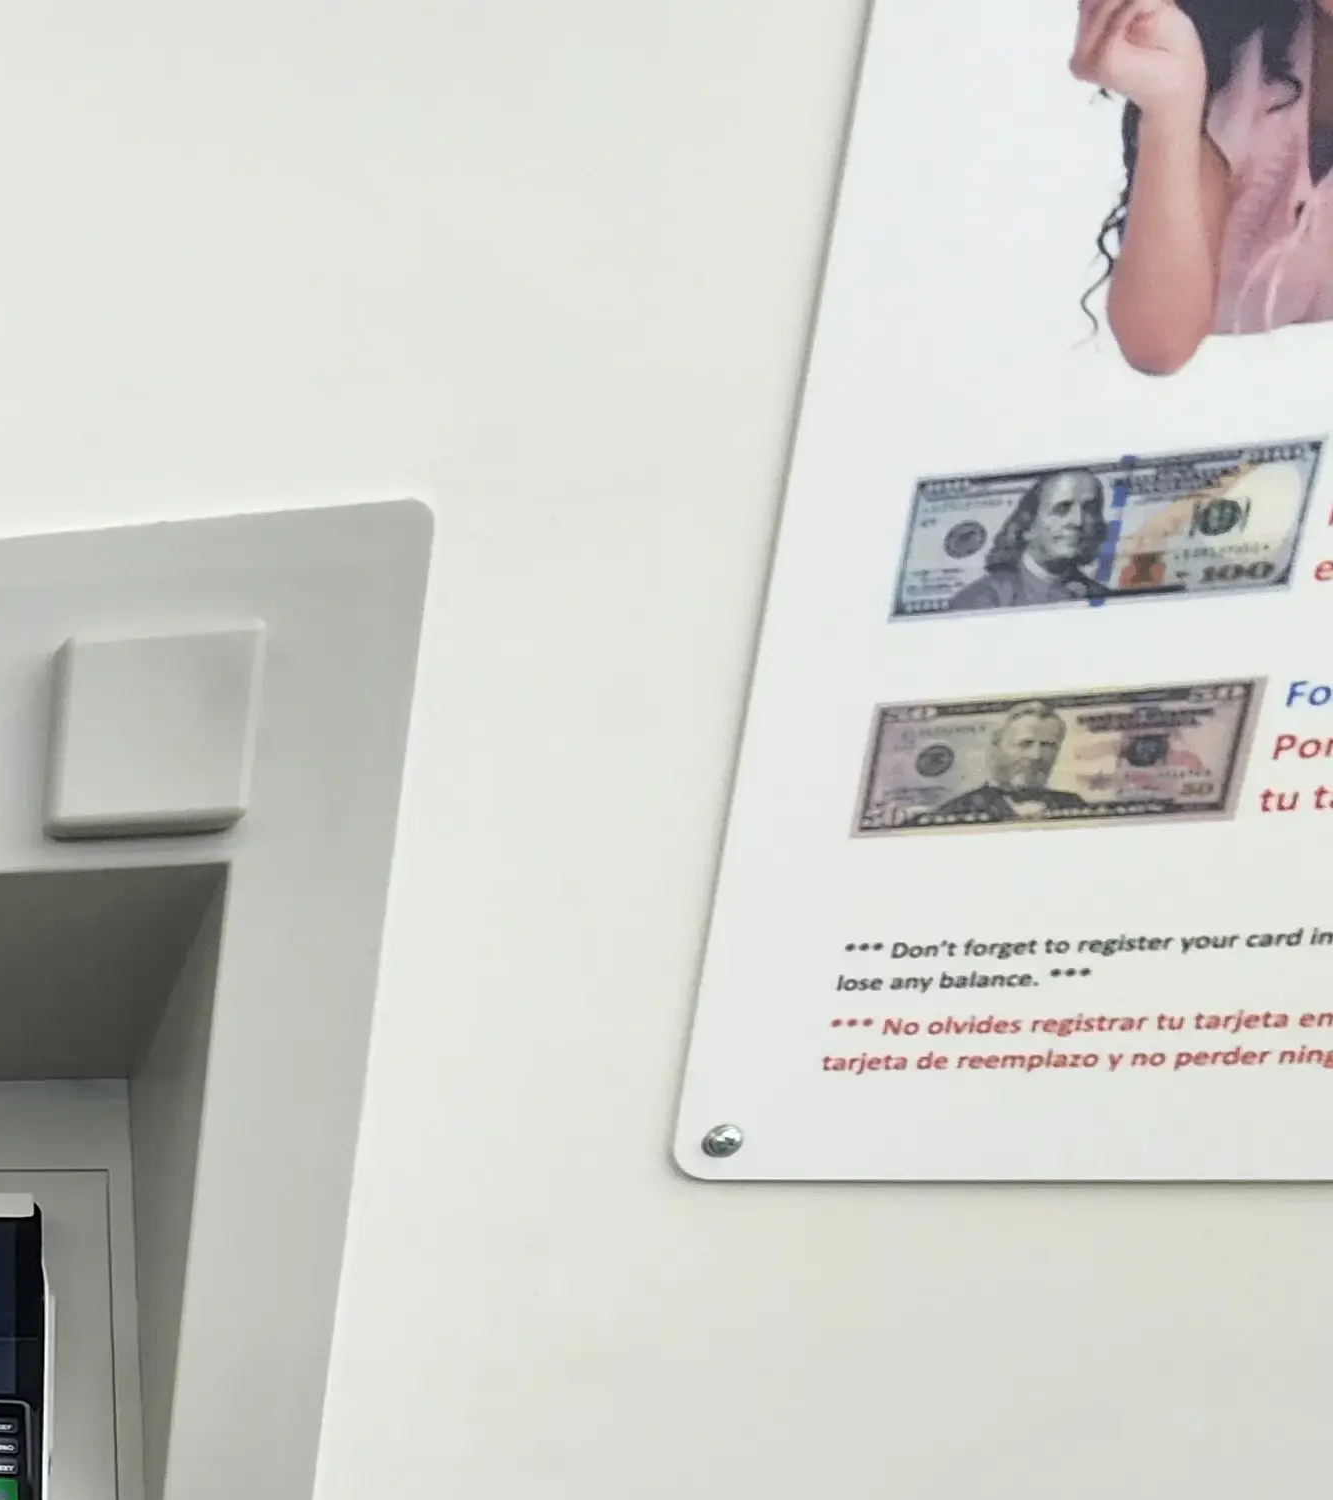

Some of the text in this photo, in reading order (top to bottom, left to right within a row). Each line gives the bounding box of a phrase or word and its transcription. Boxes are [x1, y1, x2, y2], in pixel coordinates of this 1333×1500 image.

[1260, 788, 1299, 812] tu
[891, 940, 956, 959] Don't
[964, 938, 1038, 959] forget
[1045, 939, 1070, 954] to
[1078, 933, 1174, 956] register
[1181, 934, 1240, 954] your
[1245, 927, 1304, 948] card
[836, 970, 1039, 993] lose any balance.
[881, 1009, 1333, 1037] No olvides registrar tu tarjeta en
[822, 1052, 908, 1075] tarjeta
[917, 1051, 949, 1070] de
[956, 1048, 1099, 1073] reemplazo
[1109, 1053, 1123, 1072] y
[1132, 1052, 1166, 1066] no
[1174, 1046, 1271, 1071] perder
